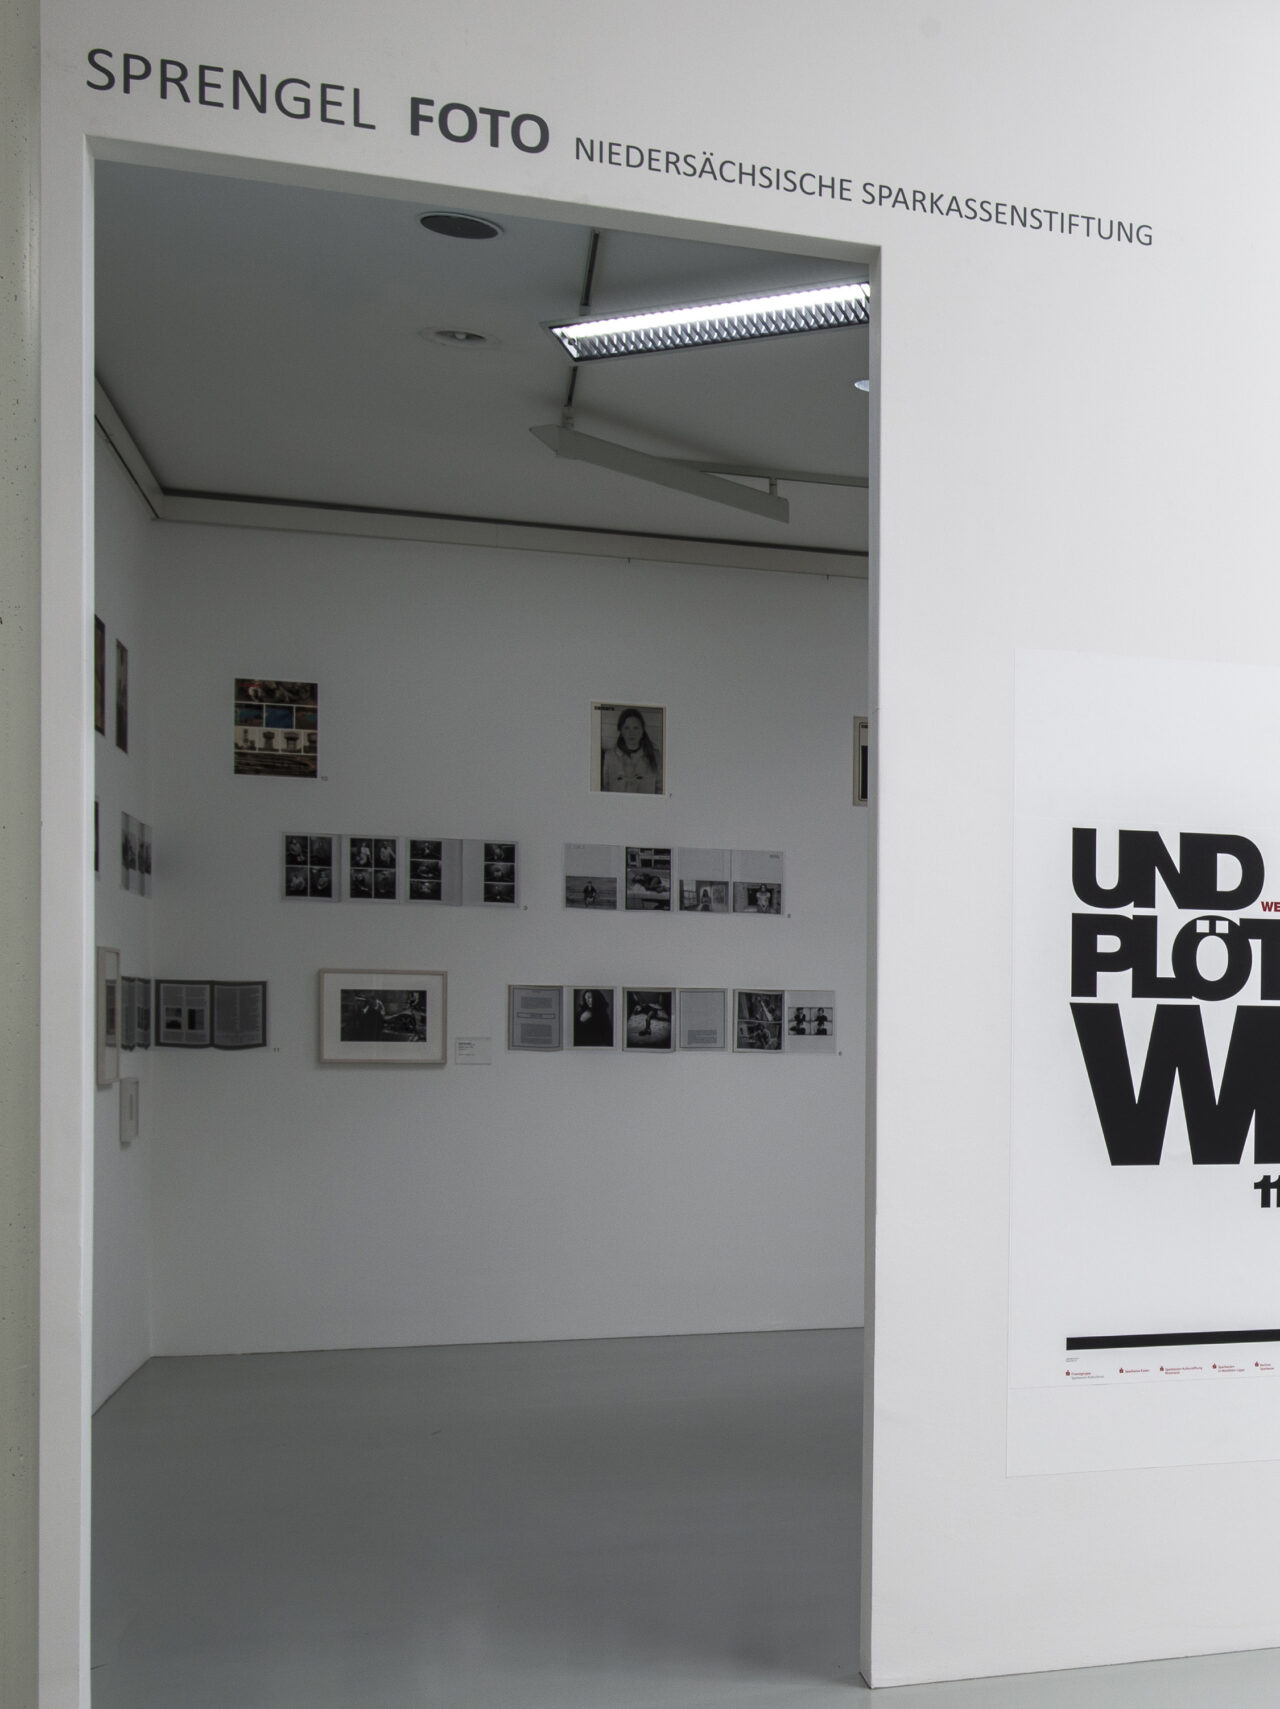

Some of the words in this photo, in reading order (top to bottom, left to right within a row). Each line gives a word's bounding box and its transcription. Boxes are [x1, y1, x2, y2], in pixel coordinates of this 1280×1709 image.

[86, 48, 376, 130] SPRENGEL
[410, 96, 550, 154] FOTO
[575, 136, 852, 201] NIEDERSÄCHSISCHE
[861, 182, 1153, 247] SPARKASSENSTIFTUNG
[1072, 827, 1265, 911] UND
